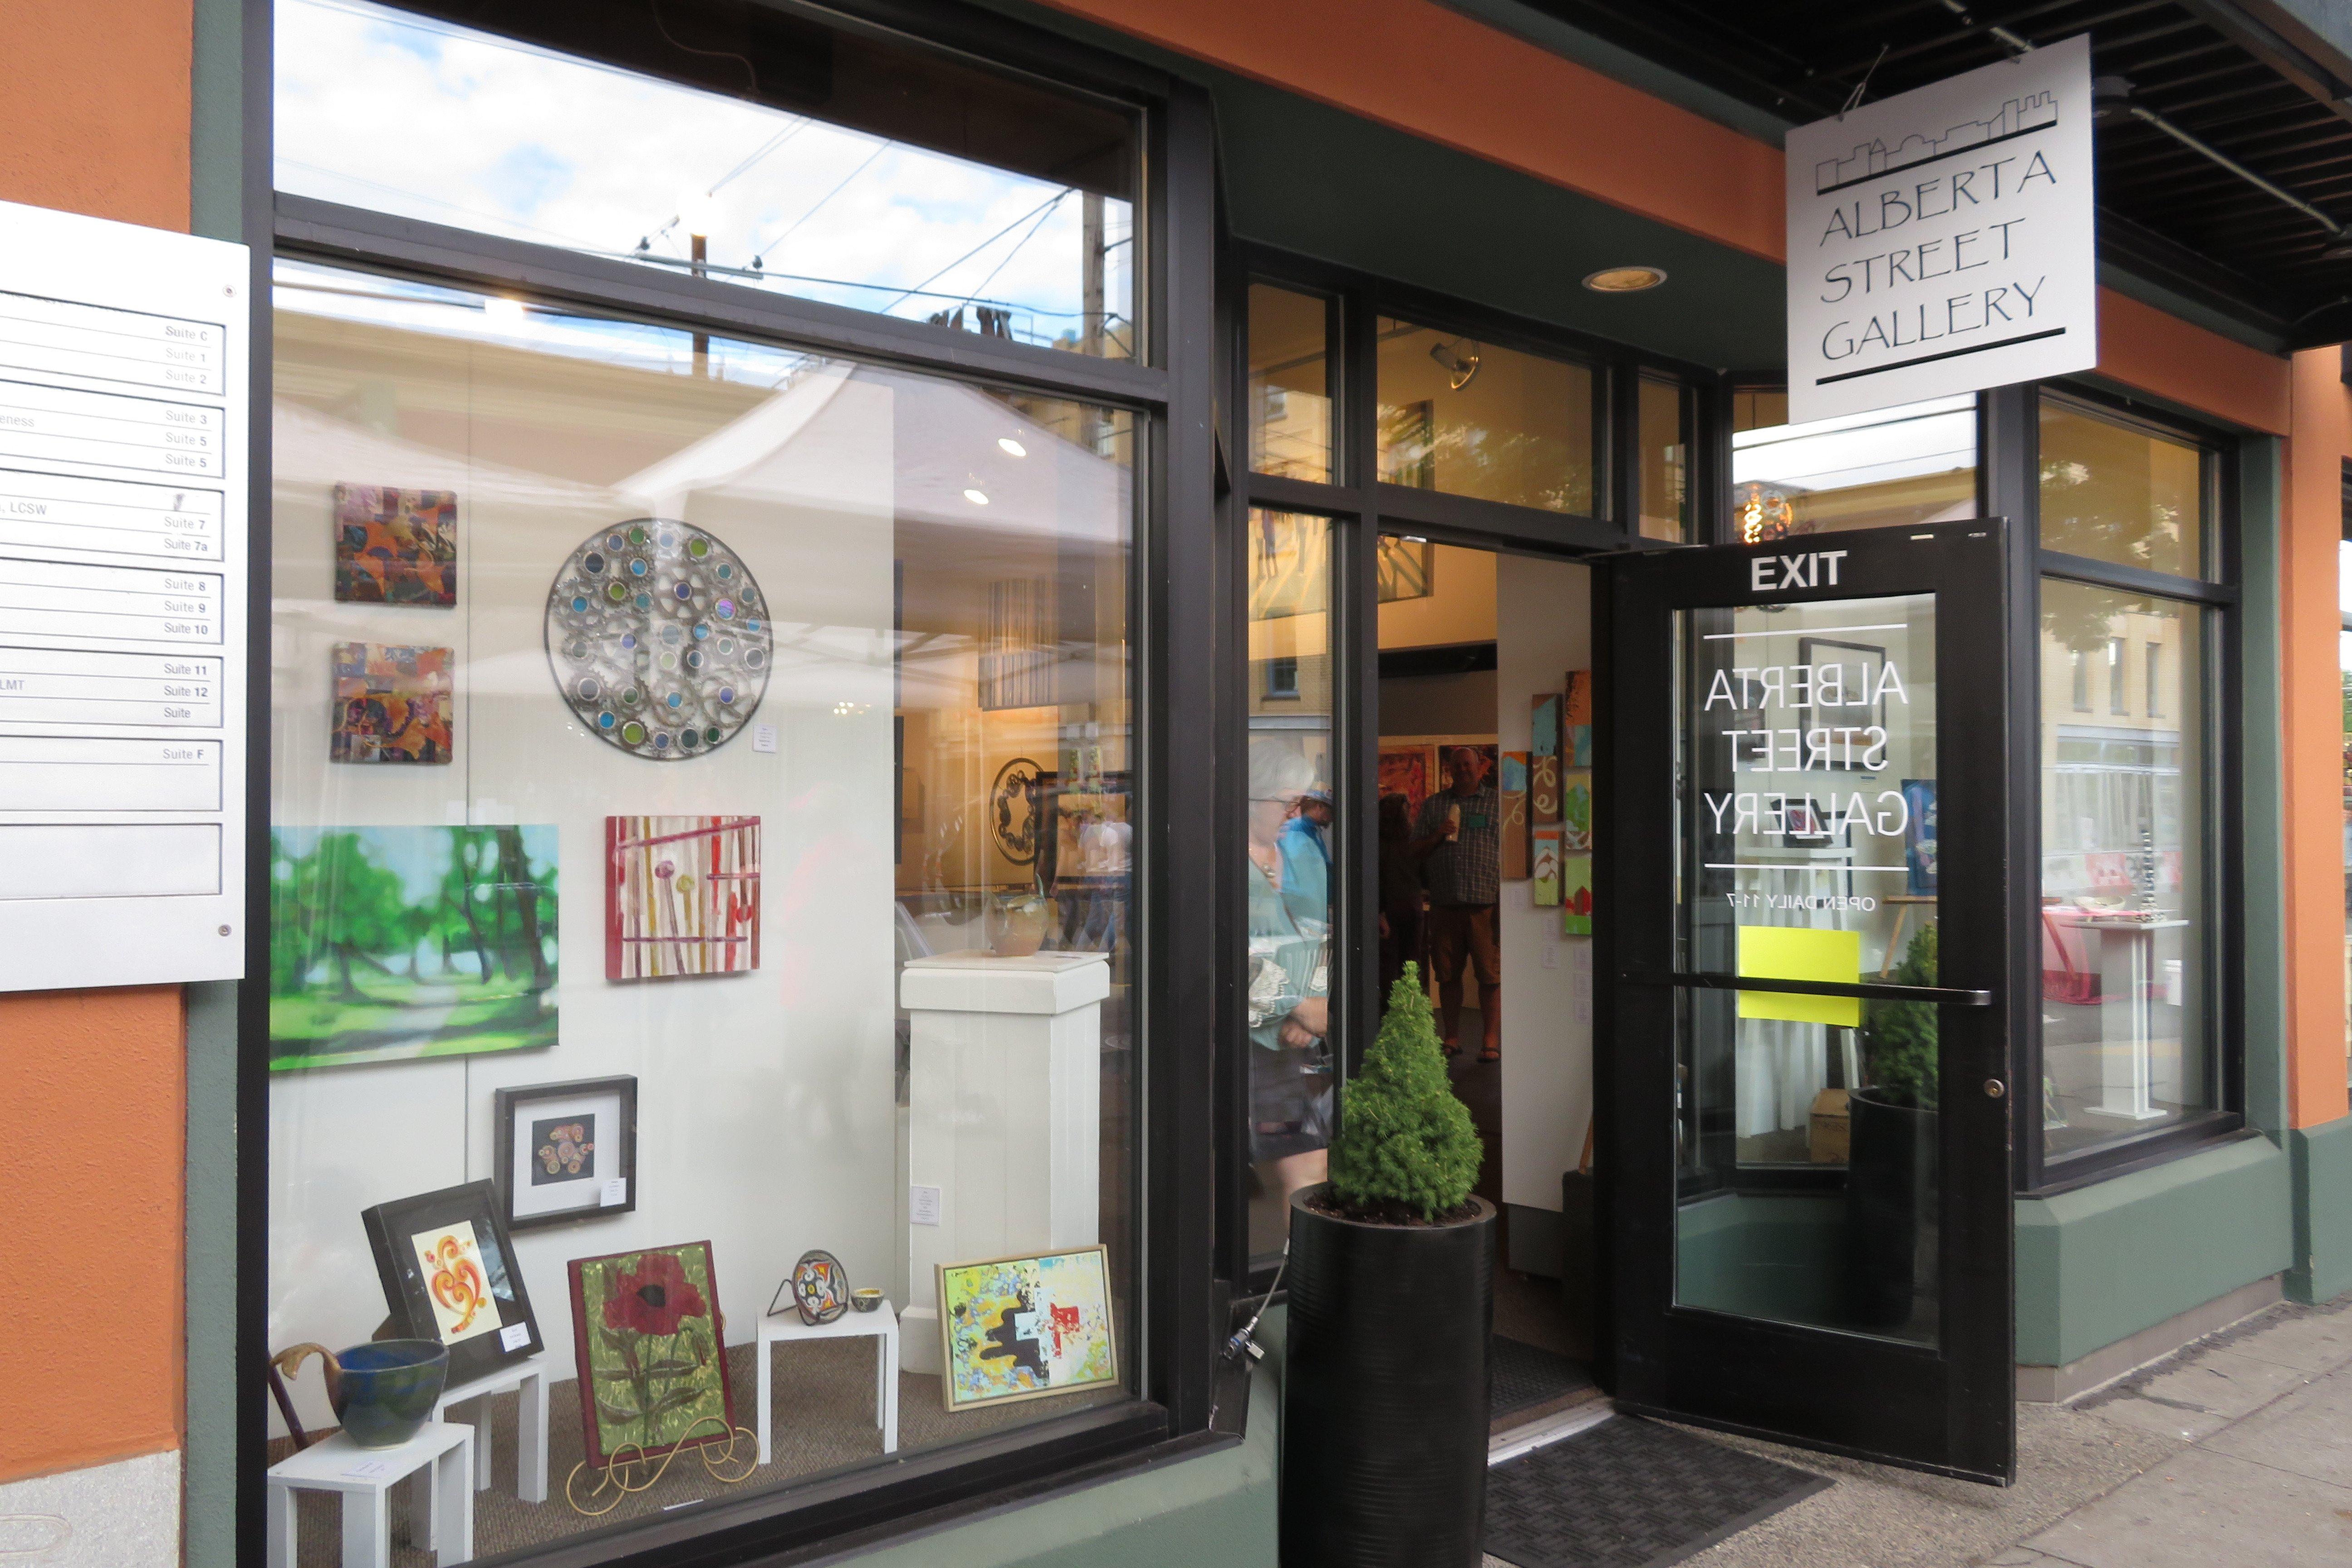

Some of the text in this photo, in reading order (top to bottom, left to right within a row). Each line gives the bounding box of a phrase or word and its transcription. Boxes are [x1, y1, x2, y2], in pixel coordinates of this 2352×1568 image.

[1819, 150, 2057, 247] ALBERTA
[1820, 218, 2026, 304] STREET
[1823, 276, 2046, 360] GALLERY
[166, 326, 208, 341] Suite C
[166, 348, 206, 363] Suite 1
[166, 369, 207, 385] Suite 2
[166, 410, 207, 425] Suite 3
[166, 431, 207, 446] Suite 5
[165, 453, 207, 468] Suite 5
[10, 501, 48, 515] LCSW
[165, 516, 206, 530] Suite 7
[164, 538, 209, 552] Suite 7a
[1751, 550, 1847, 591] EXIT
[165, 578, 206, 592] Suite 8
[165, 600, 206, 614] Suite 9
[164, 622, 209, 636] Suite 10
[164, 663, 208, 676] Suite 11
[164, 685, 209, 698] Suite 12
[164, 707, 191, 719] Suite
[162, 749, 205, 760] Suite F
